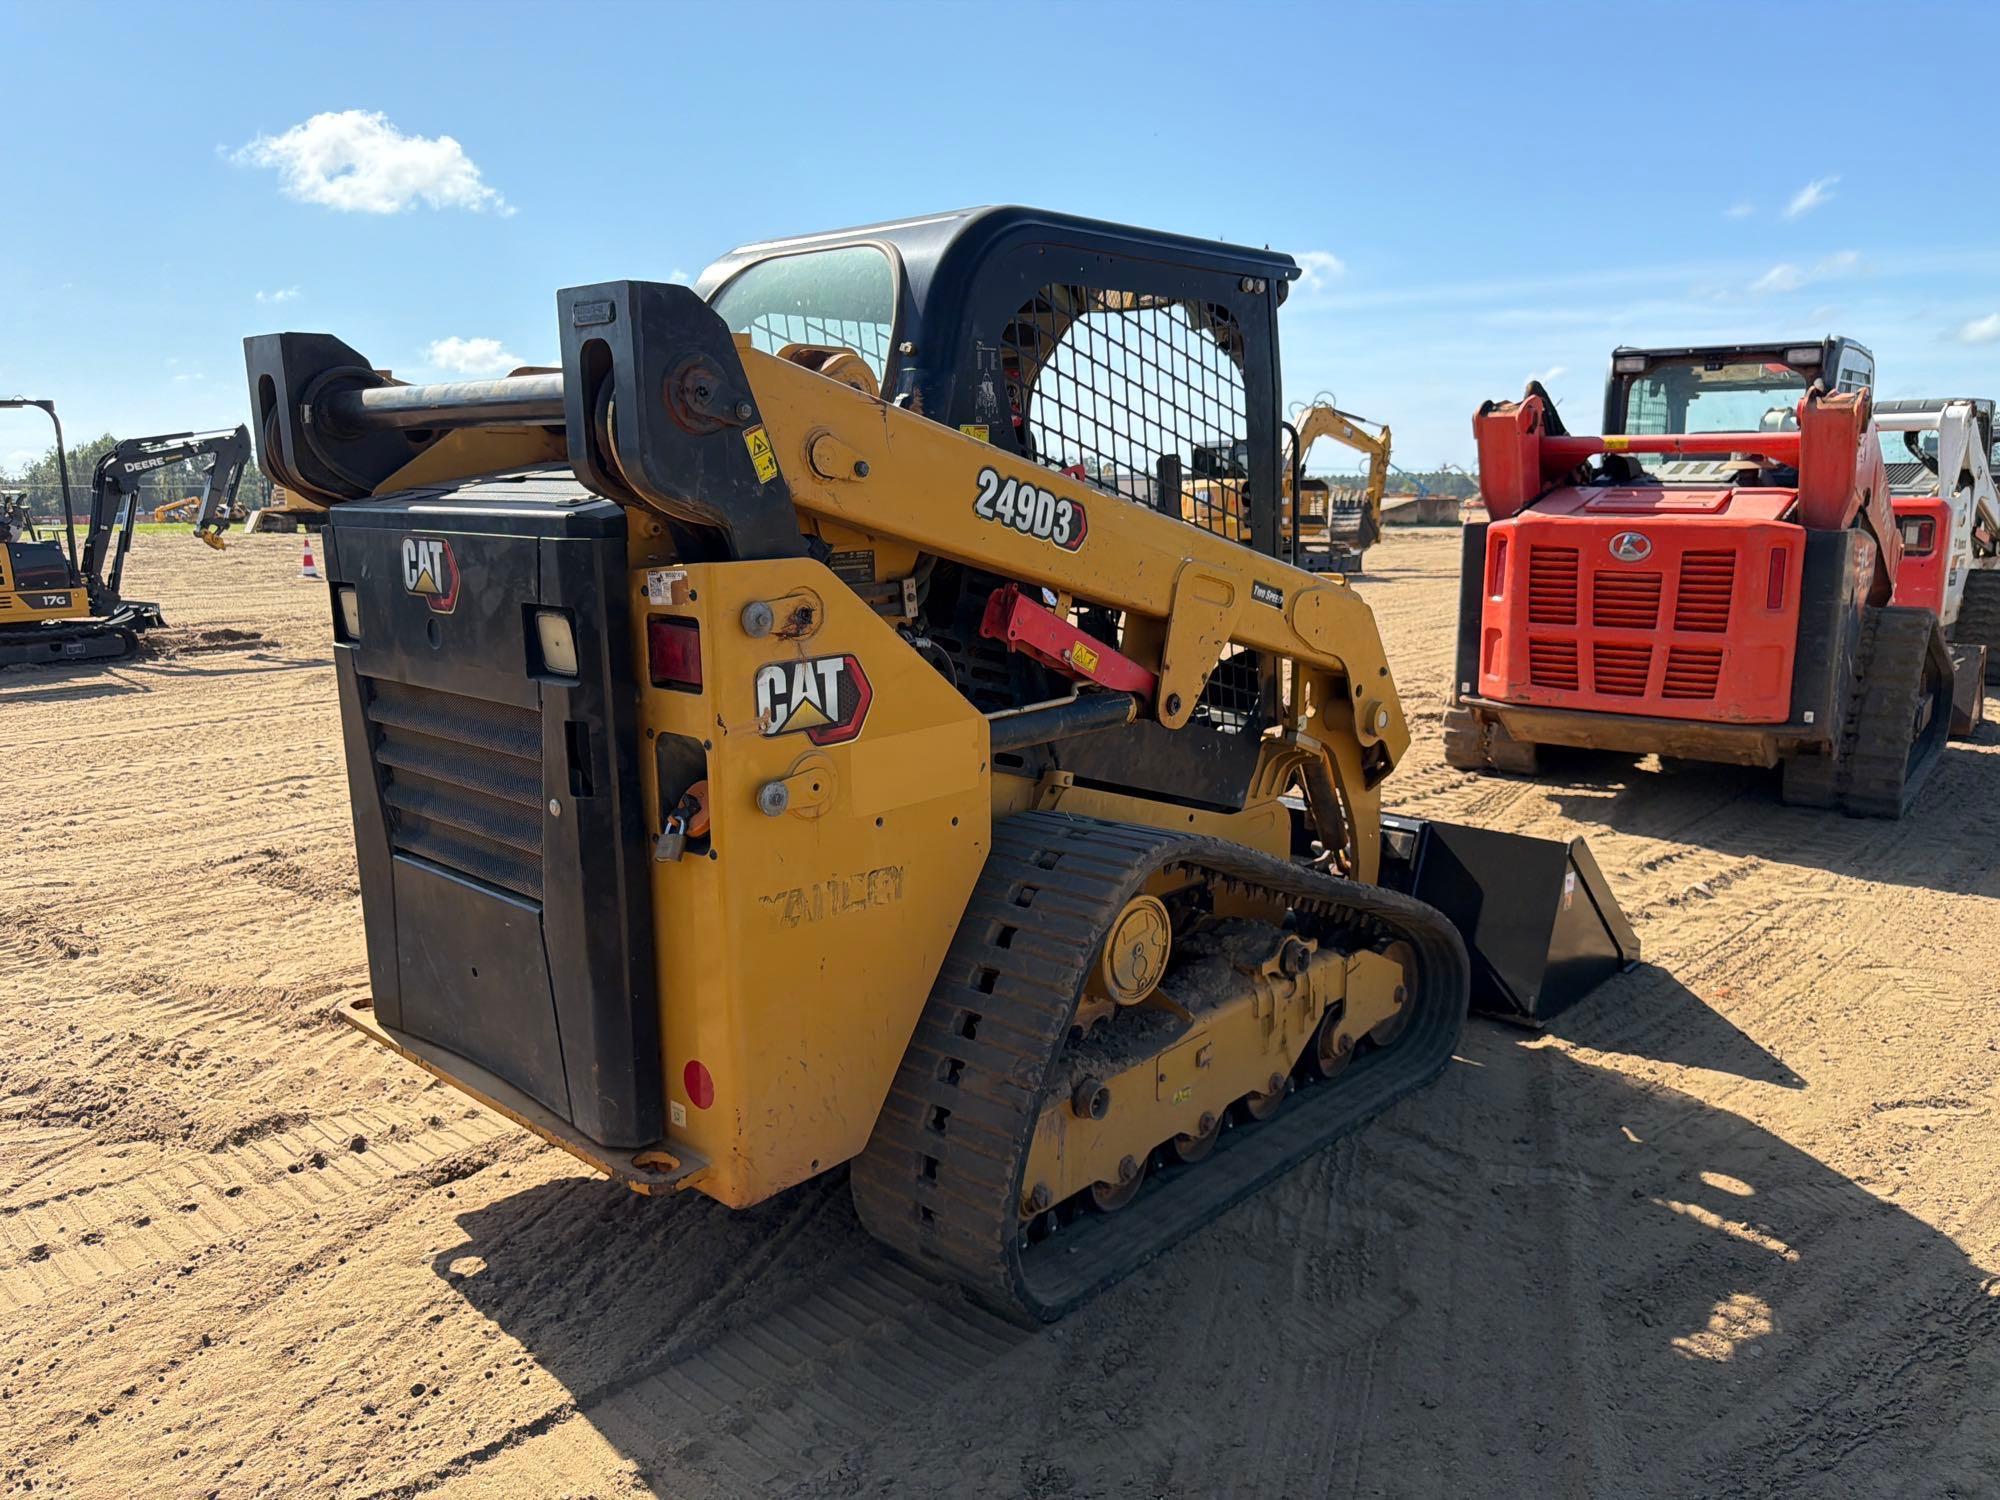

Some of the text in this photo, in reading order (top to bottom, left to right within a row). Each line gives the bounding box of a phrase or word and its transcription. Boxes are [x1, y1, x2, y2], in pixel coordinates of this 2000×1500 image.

[124, 457, 166, 473] DEERE
[976, 469, 1074, 544] 249D3
[402, 538, 444, 594] CAT
[42, 595, 66, 606] 17G
[757, 657, 844, 735] CAT
